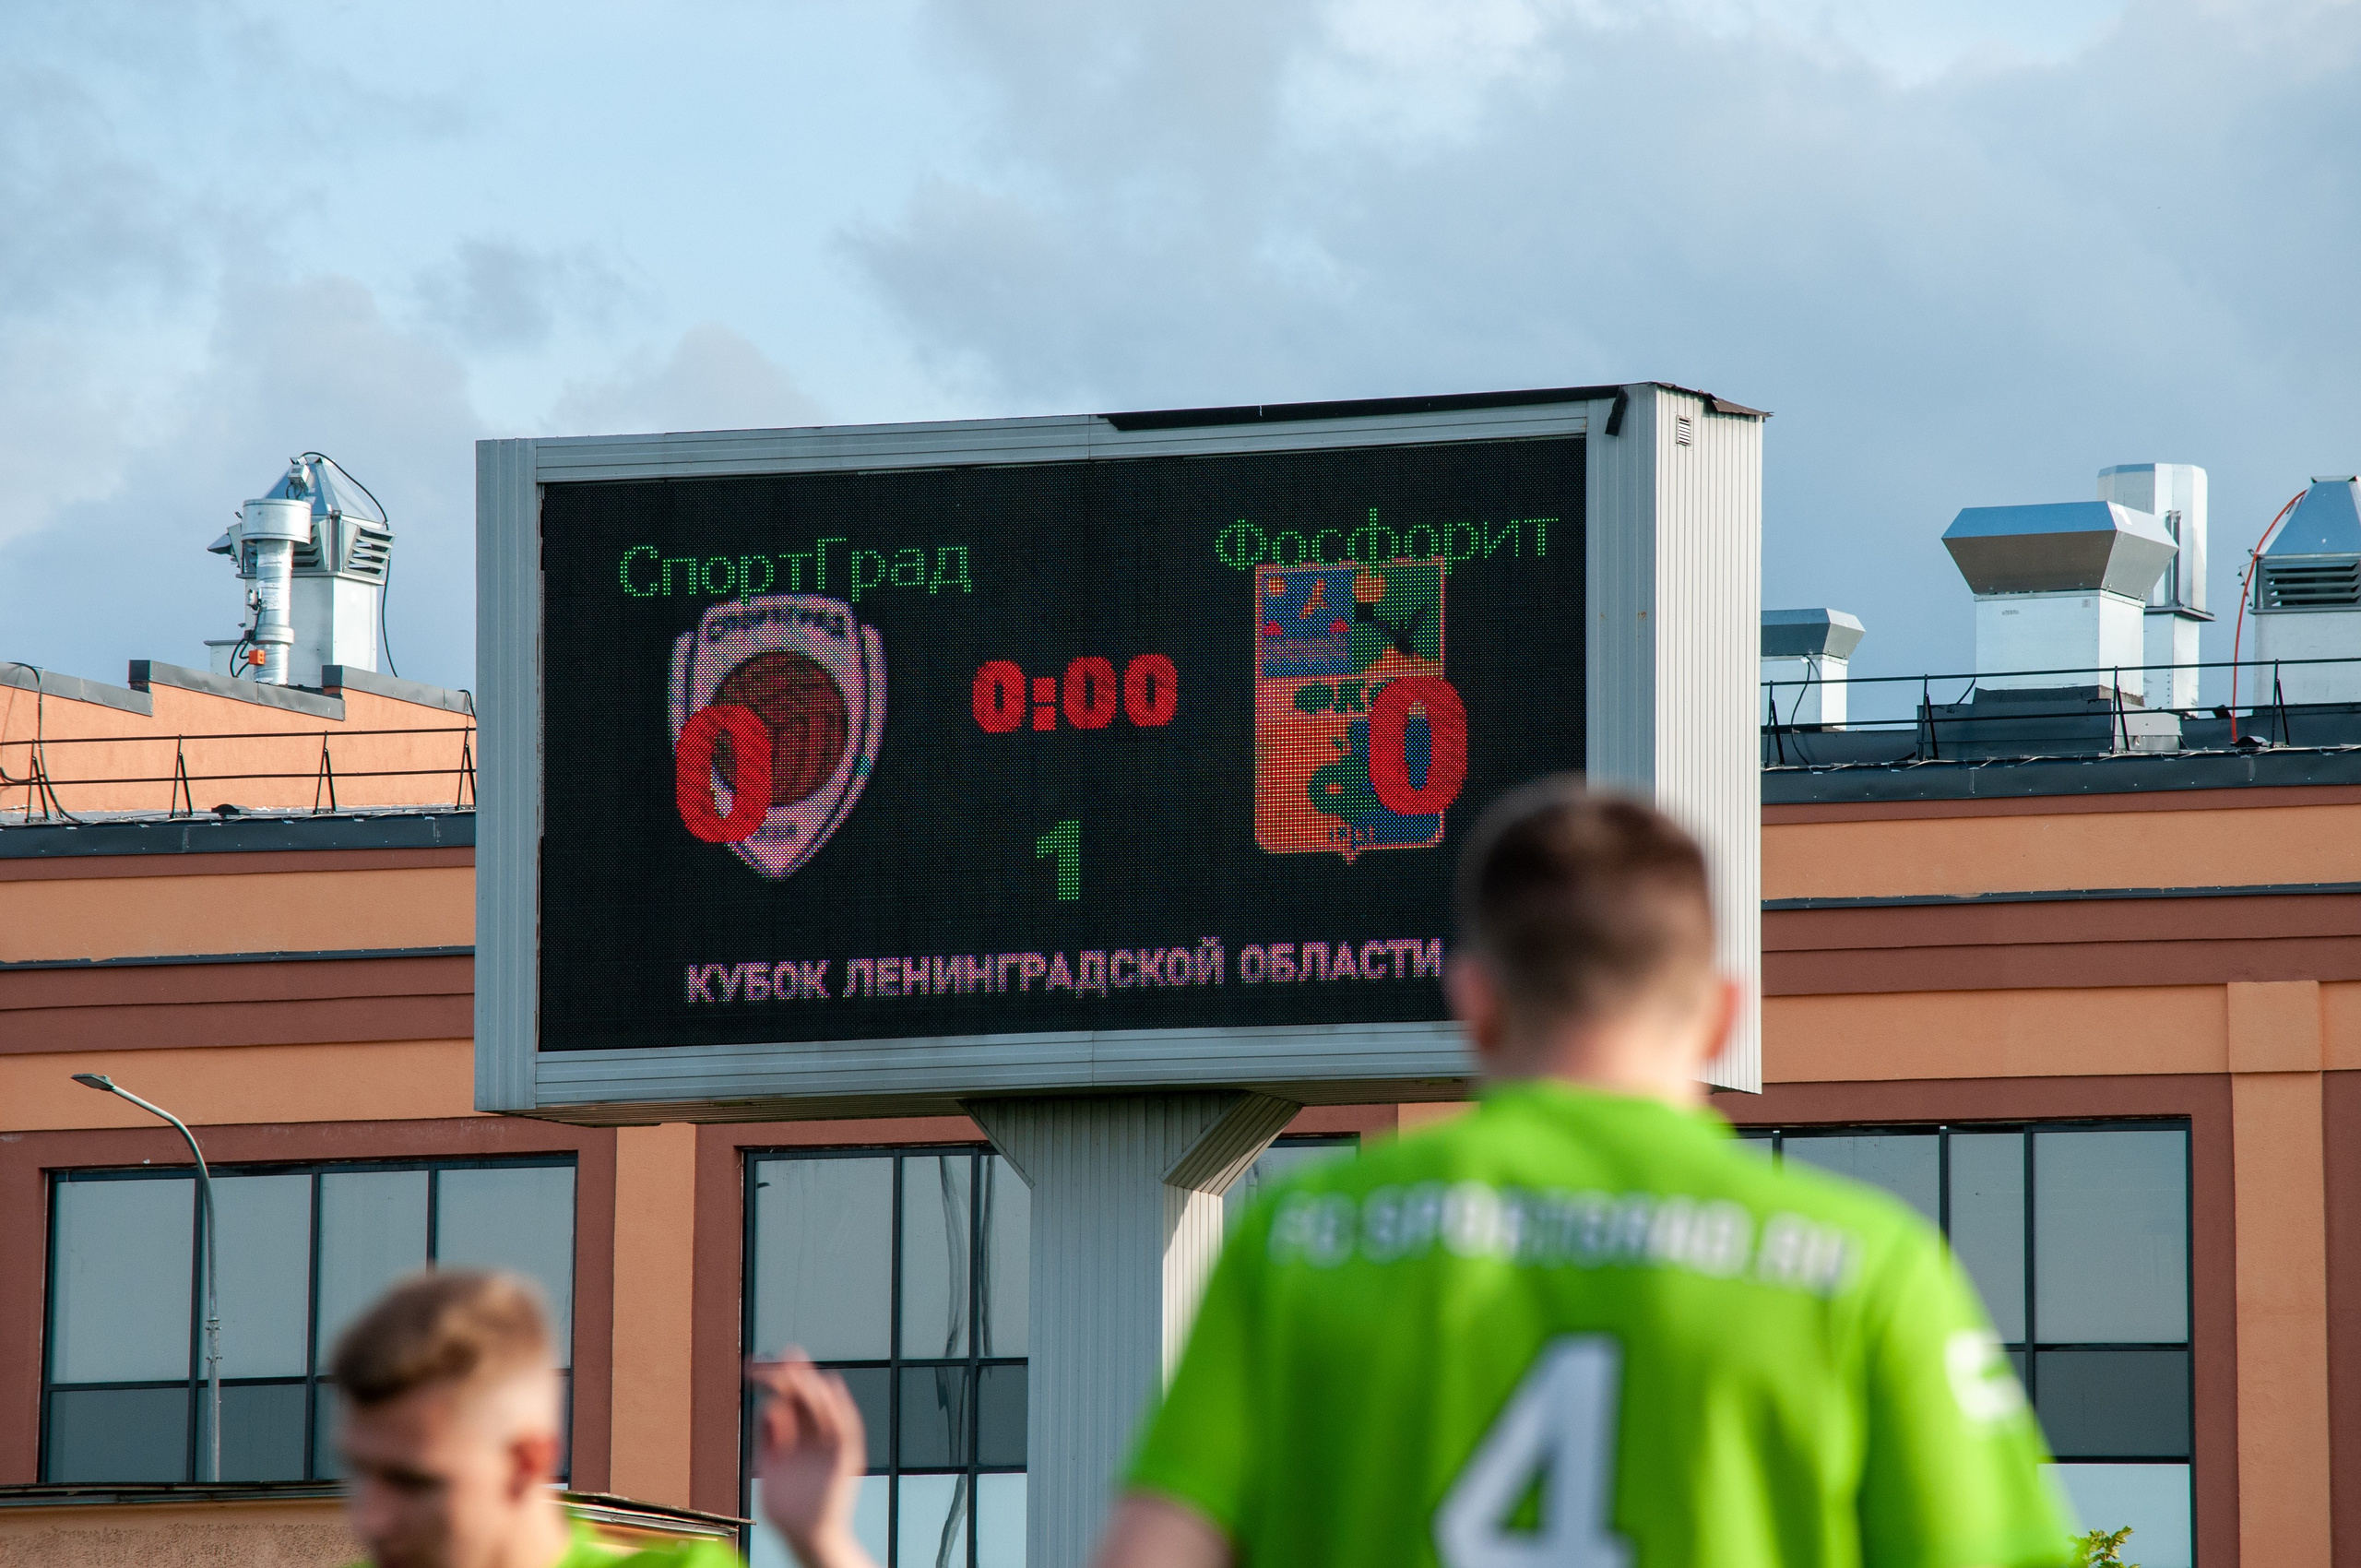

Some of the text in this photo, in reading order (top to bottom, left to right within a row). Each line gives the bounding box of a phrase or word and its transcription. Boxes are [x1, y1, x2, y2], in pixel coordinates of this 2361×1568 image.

[619, 537, 972, 606] СпортГрад
[1215, 508, 1559, 577] Фосфорит
[971, 653, 1179, 733] 0:00
[675, 704, 772, 843] 0
[1368, 674, 1467, 816] 0
[1036, 819, 1080, 900] 1
[685, 935, 1444, 1004] КУБОК ЛЕНИНГРАДСКОЙ ОБЛАСТИ
[1432, 1332, 1637, 1568] 4
